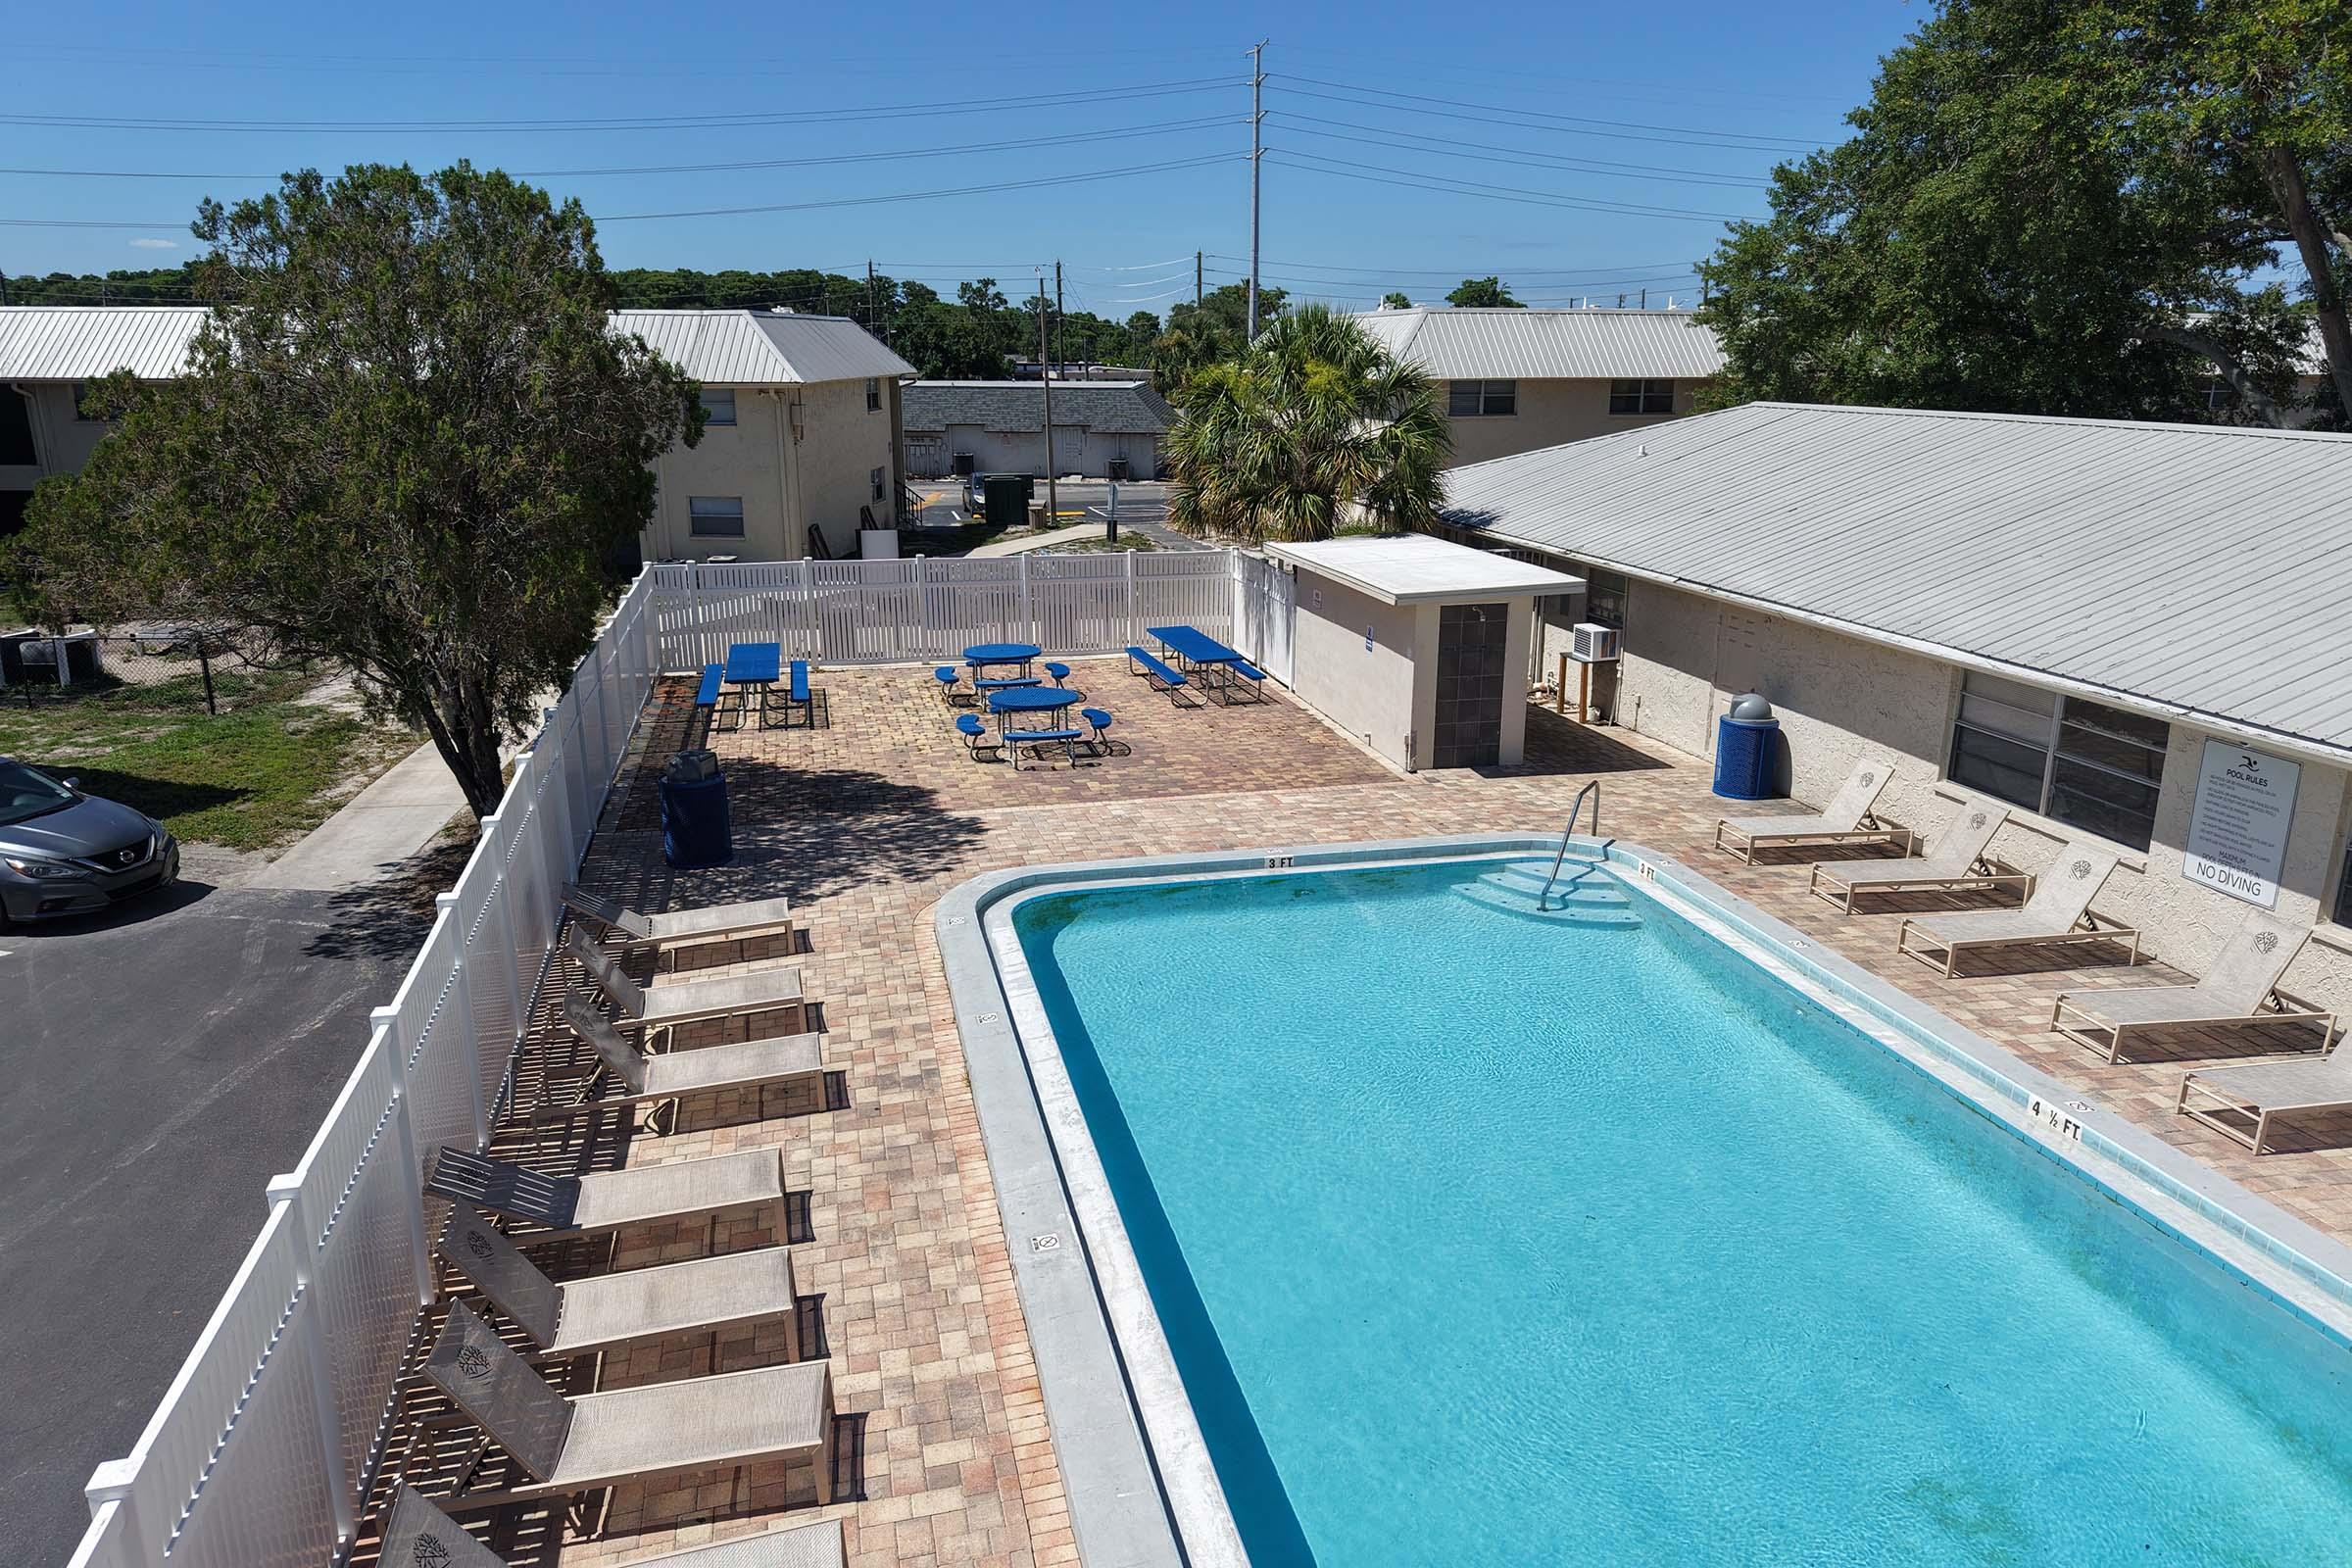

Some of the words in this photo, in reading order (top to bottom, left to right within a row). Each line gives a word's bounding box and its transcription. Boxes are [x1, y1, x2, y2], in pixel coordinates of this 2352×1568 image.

[2227, 768, 2244, 780] POOL
[2245, 774, 2268, 787] RULES
[1269, 858, 1275, 868] 3
[1641, 863, 1645, 873] 3
[2197, 862, 2215, 879] NO
[2218, 869, 2262, 897] DIVING
[2032, 1101, 2040, 1116] 4
